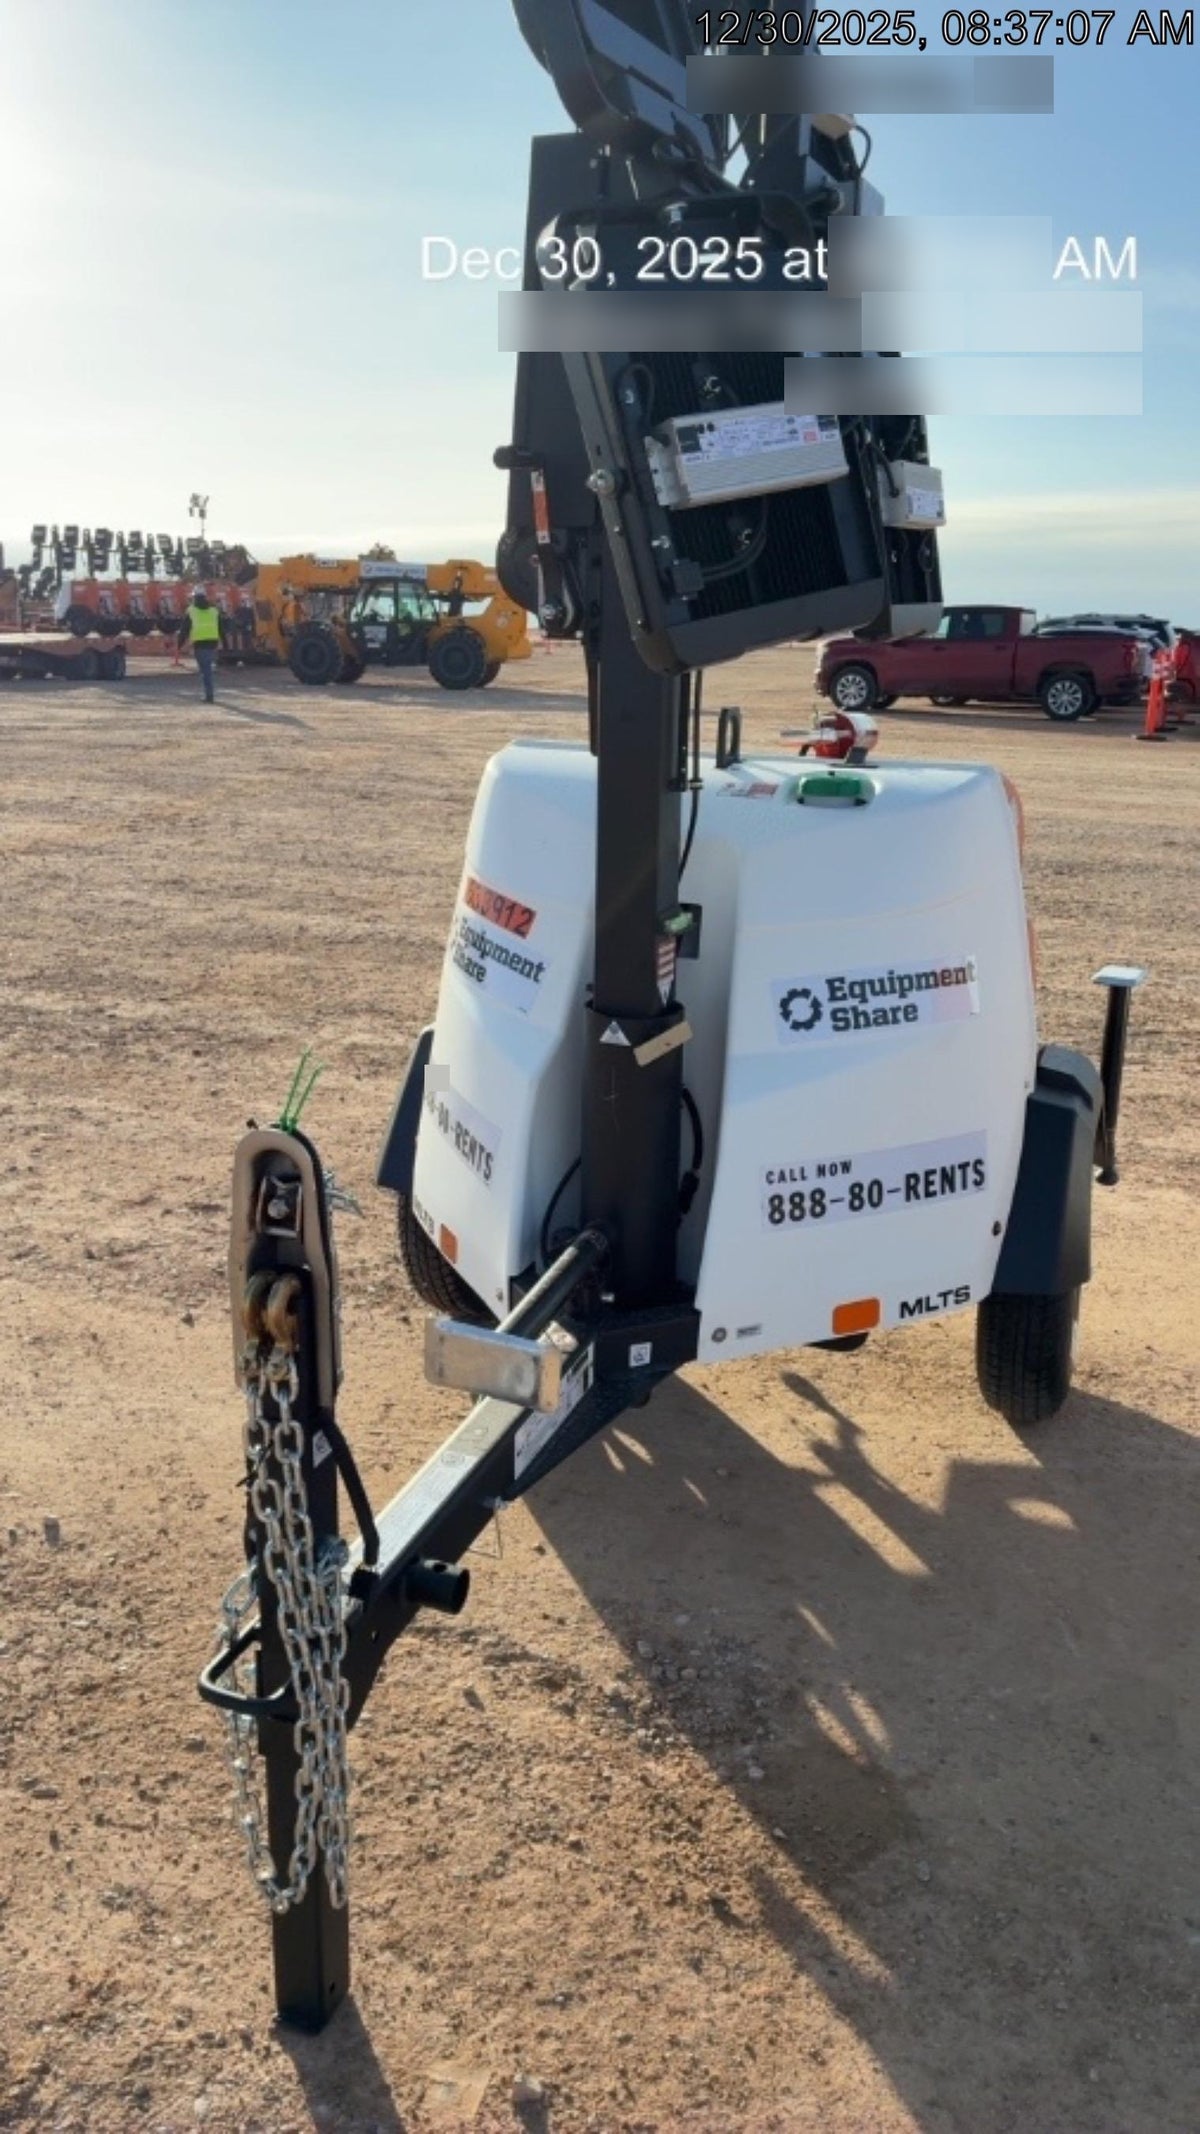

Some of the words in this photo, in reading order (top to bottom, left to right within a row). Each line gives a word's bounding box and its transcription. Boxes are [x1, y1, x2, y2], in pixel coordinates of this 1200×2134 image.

[825, 960, 976, 1004] Equipment
[830, 1002, 919, 1032] Share
[766, 1166, 808, 1184] CALL
[817, 1160, 852, 1178] NOW
[768, 1158, 985, 1225] 888-80-RENTS
[900, 1285, 971, 1319] MLTS
